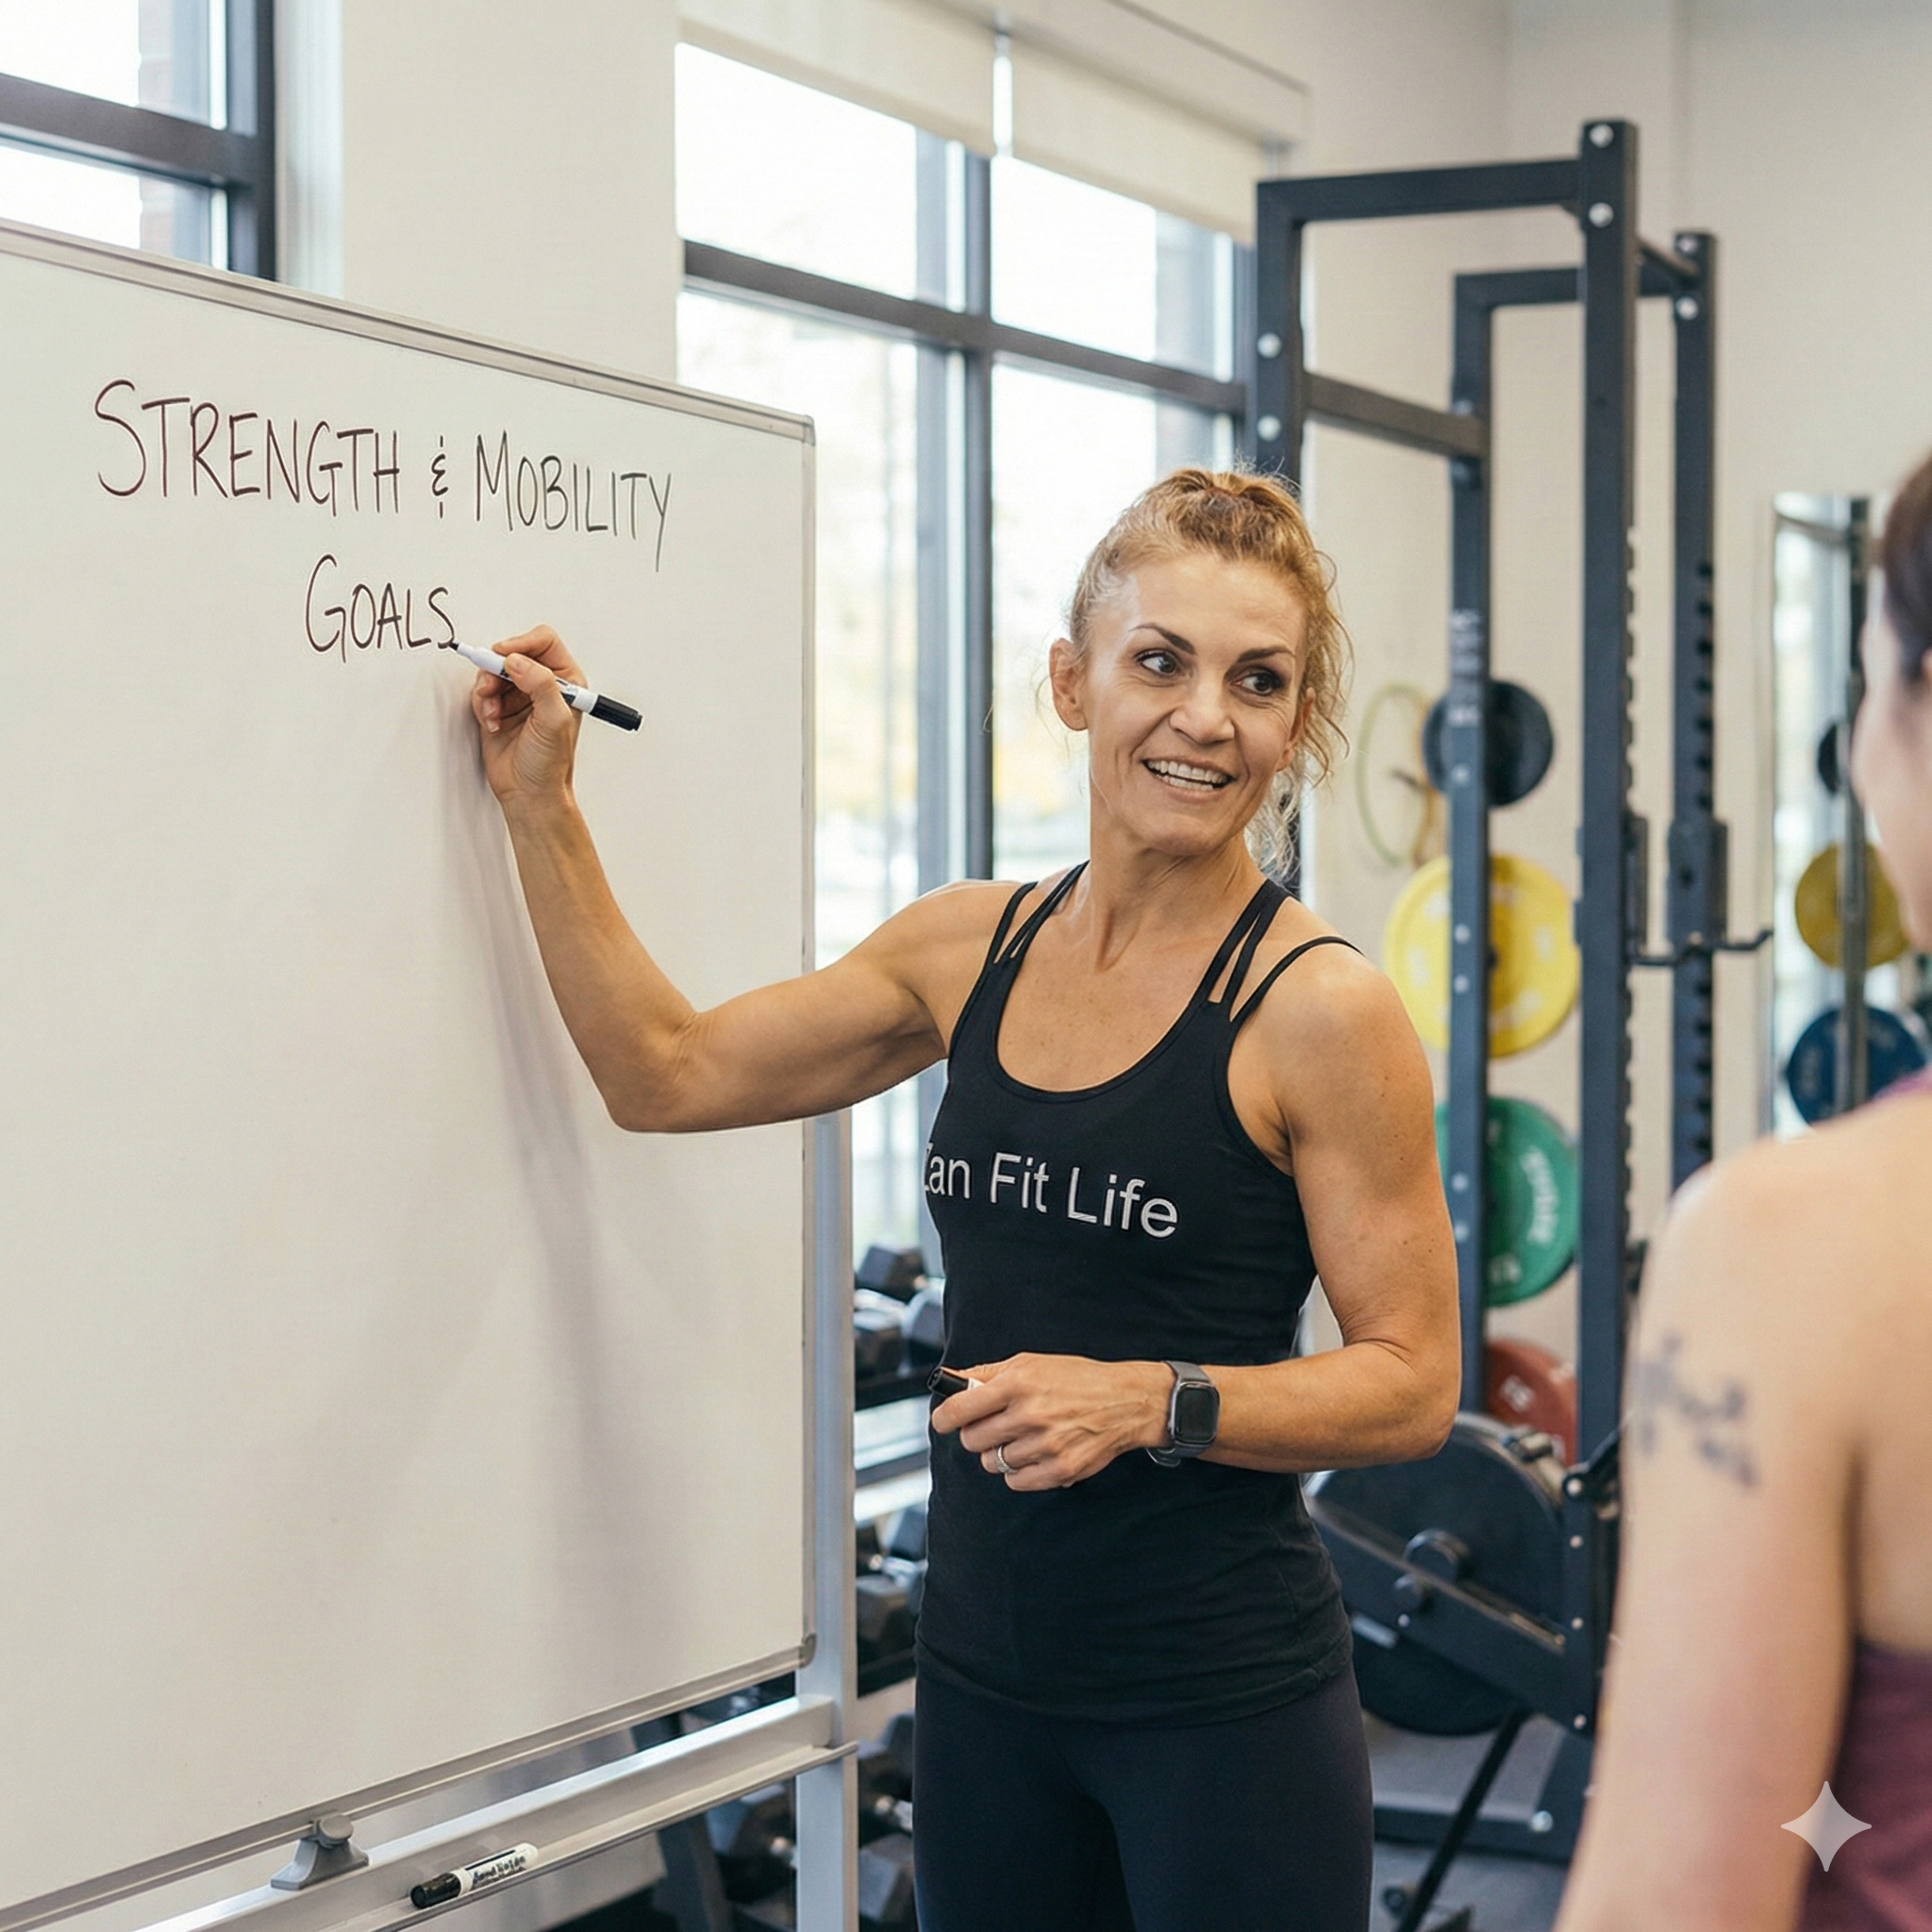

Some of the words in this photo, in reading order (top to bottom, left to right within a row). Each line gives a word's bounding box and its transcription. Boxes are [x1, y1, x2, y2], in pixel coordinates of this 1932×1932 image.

[94, 379, 400, 516] STRENGTH
[430, 435, 449, 519] &
[475, 430, 672, 573] MOBILITY
[305, 554, 455, 663] GOALS
[991, 1152, 1049, 1213] Fit
[1068, 1166, 1178, 1238] Life
